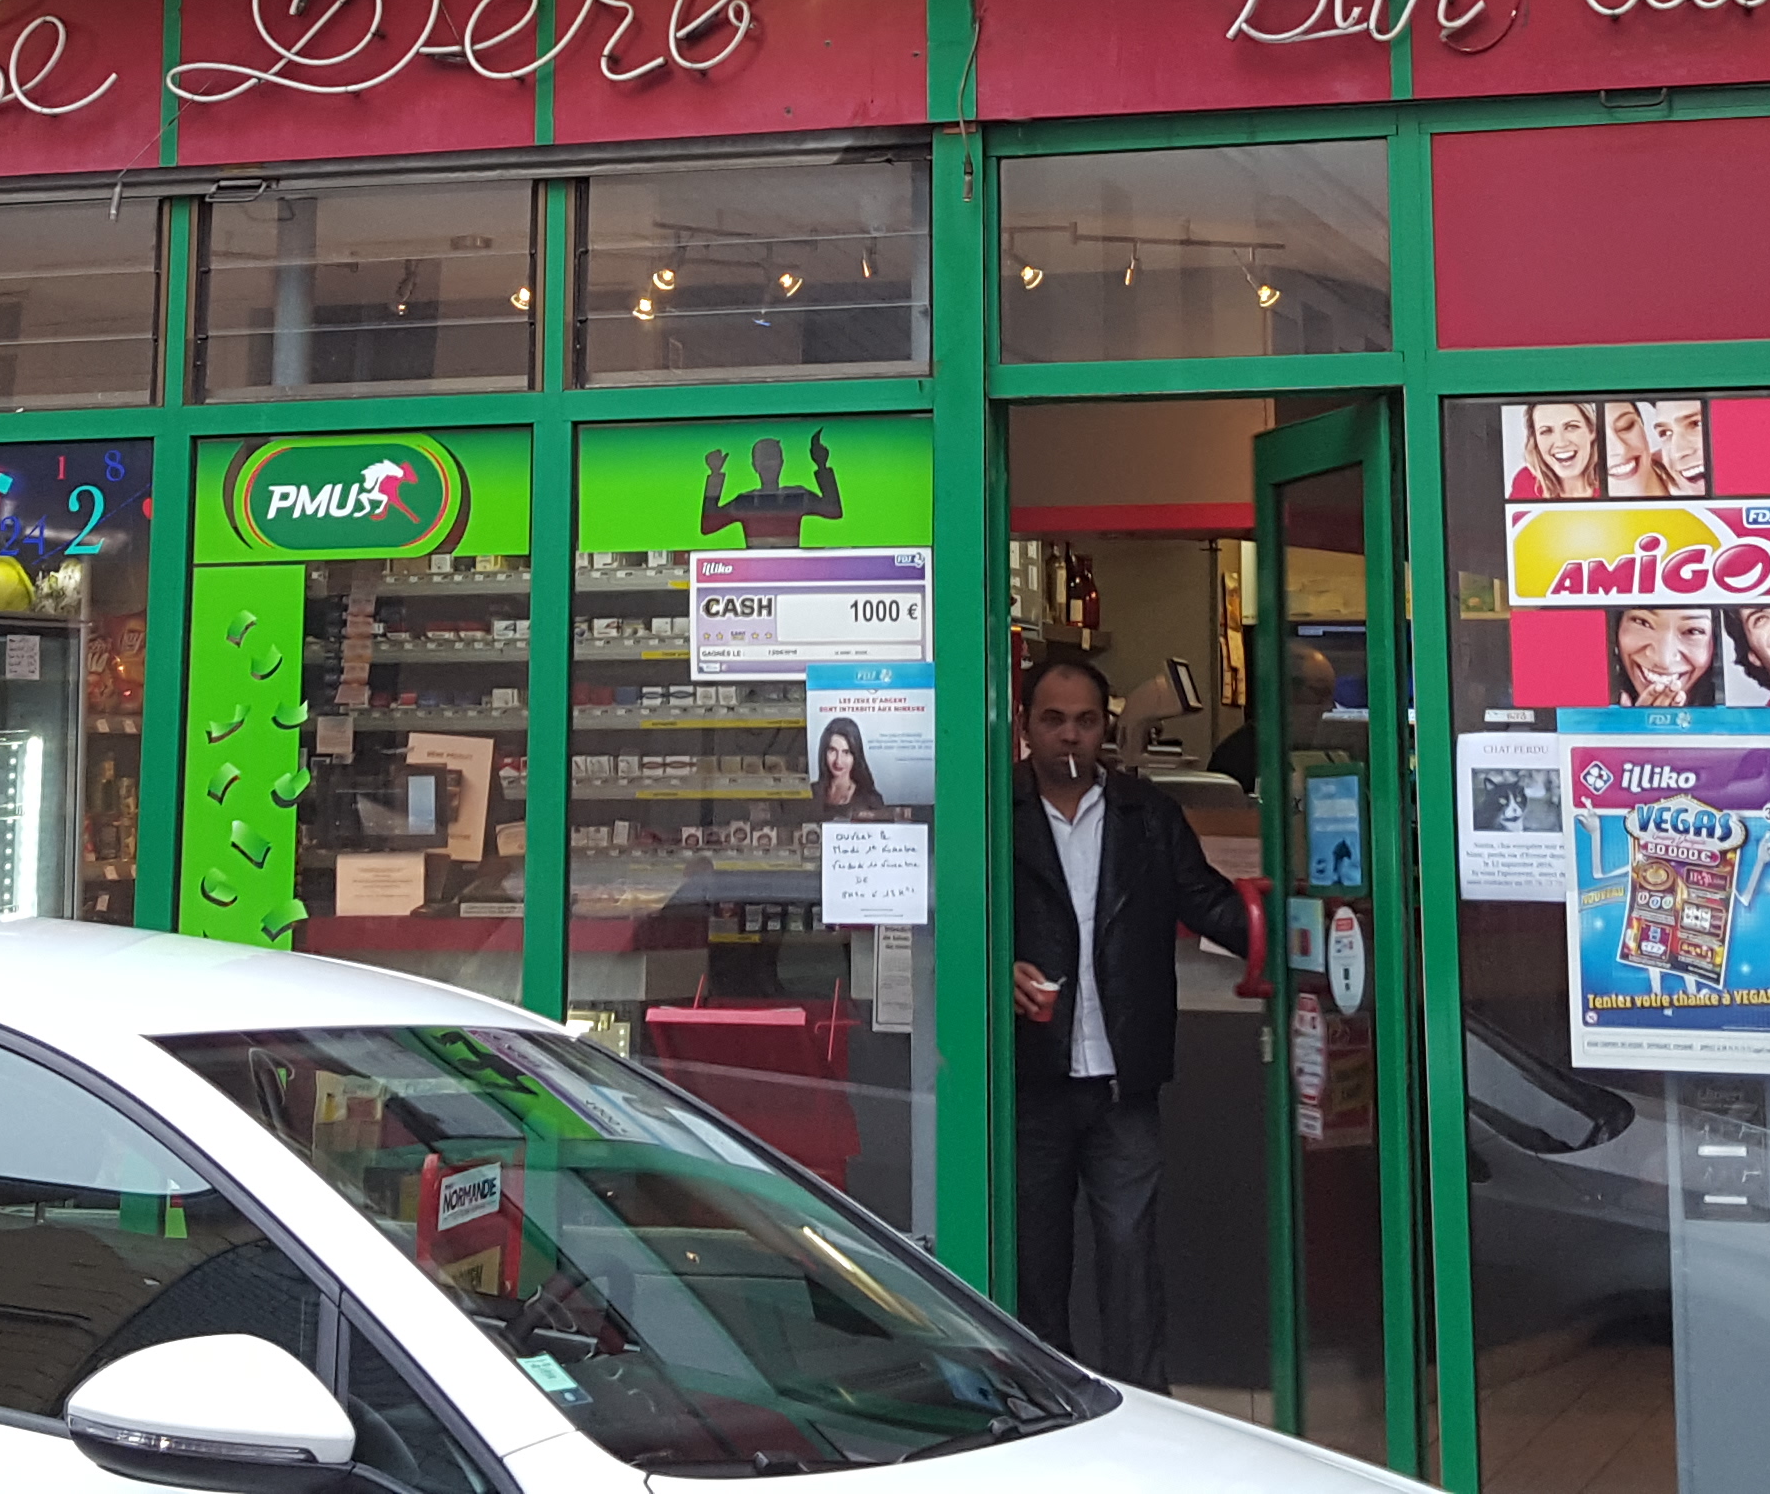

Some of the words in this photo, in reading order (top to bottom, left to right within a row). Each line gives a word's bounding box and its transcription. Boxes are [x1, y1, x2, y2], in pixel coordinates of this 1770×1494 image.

[55, 455, 67, 481] 1
[103, 450, 126, 482] 8
[266, 483, 360, 520] PMU
[63, 484, 105, 555] 2
[702, 562, 733, 576] illiko
[702, 595, 773, 619] CASH
[849, 599, 900, 623] 1000
[907, 603, 919, 621] €
[1483, 745, 1511, 755] CHAT
[1513, 745, 1549, 755] PERDU
[1621, 763, 1697, 794] illiko
[1636, 804, 1734, 843] VEGAS
[1587, 994, 1632, 1010] Tentez
[1635, 994, 1671, 1007] votre
[1673, 991, 1720, 1006] chance
[1722, 991, 1731, 1004] à
